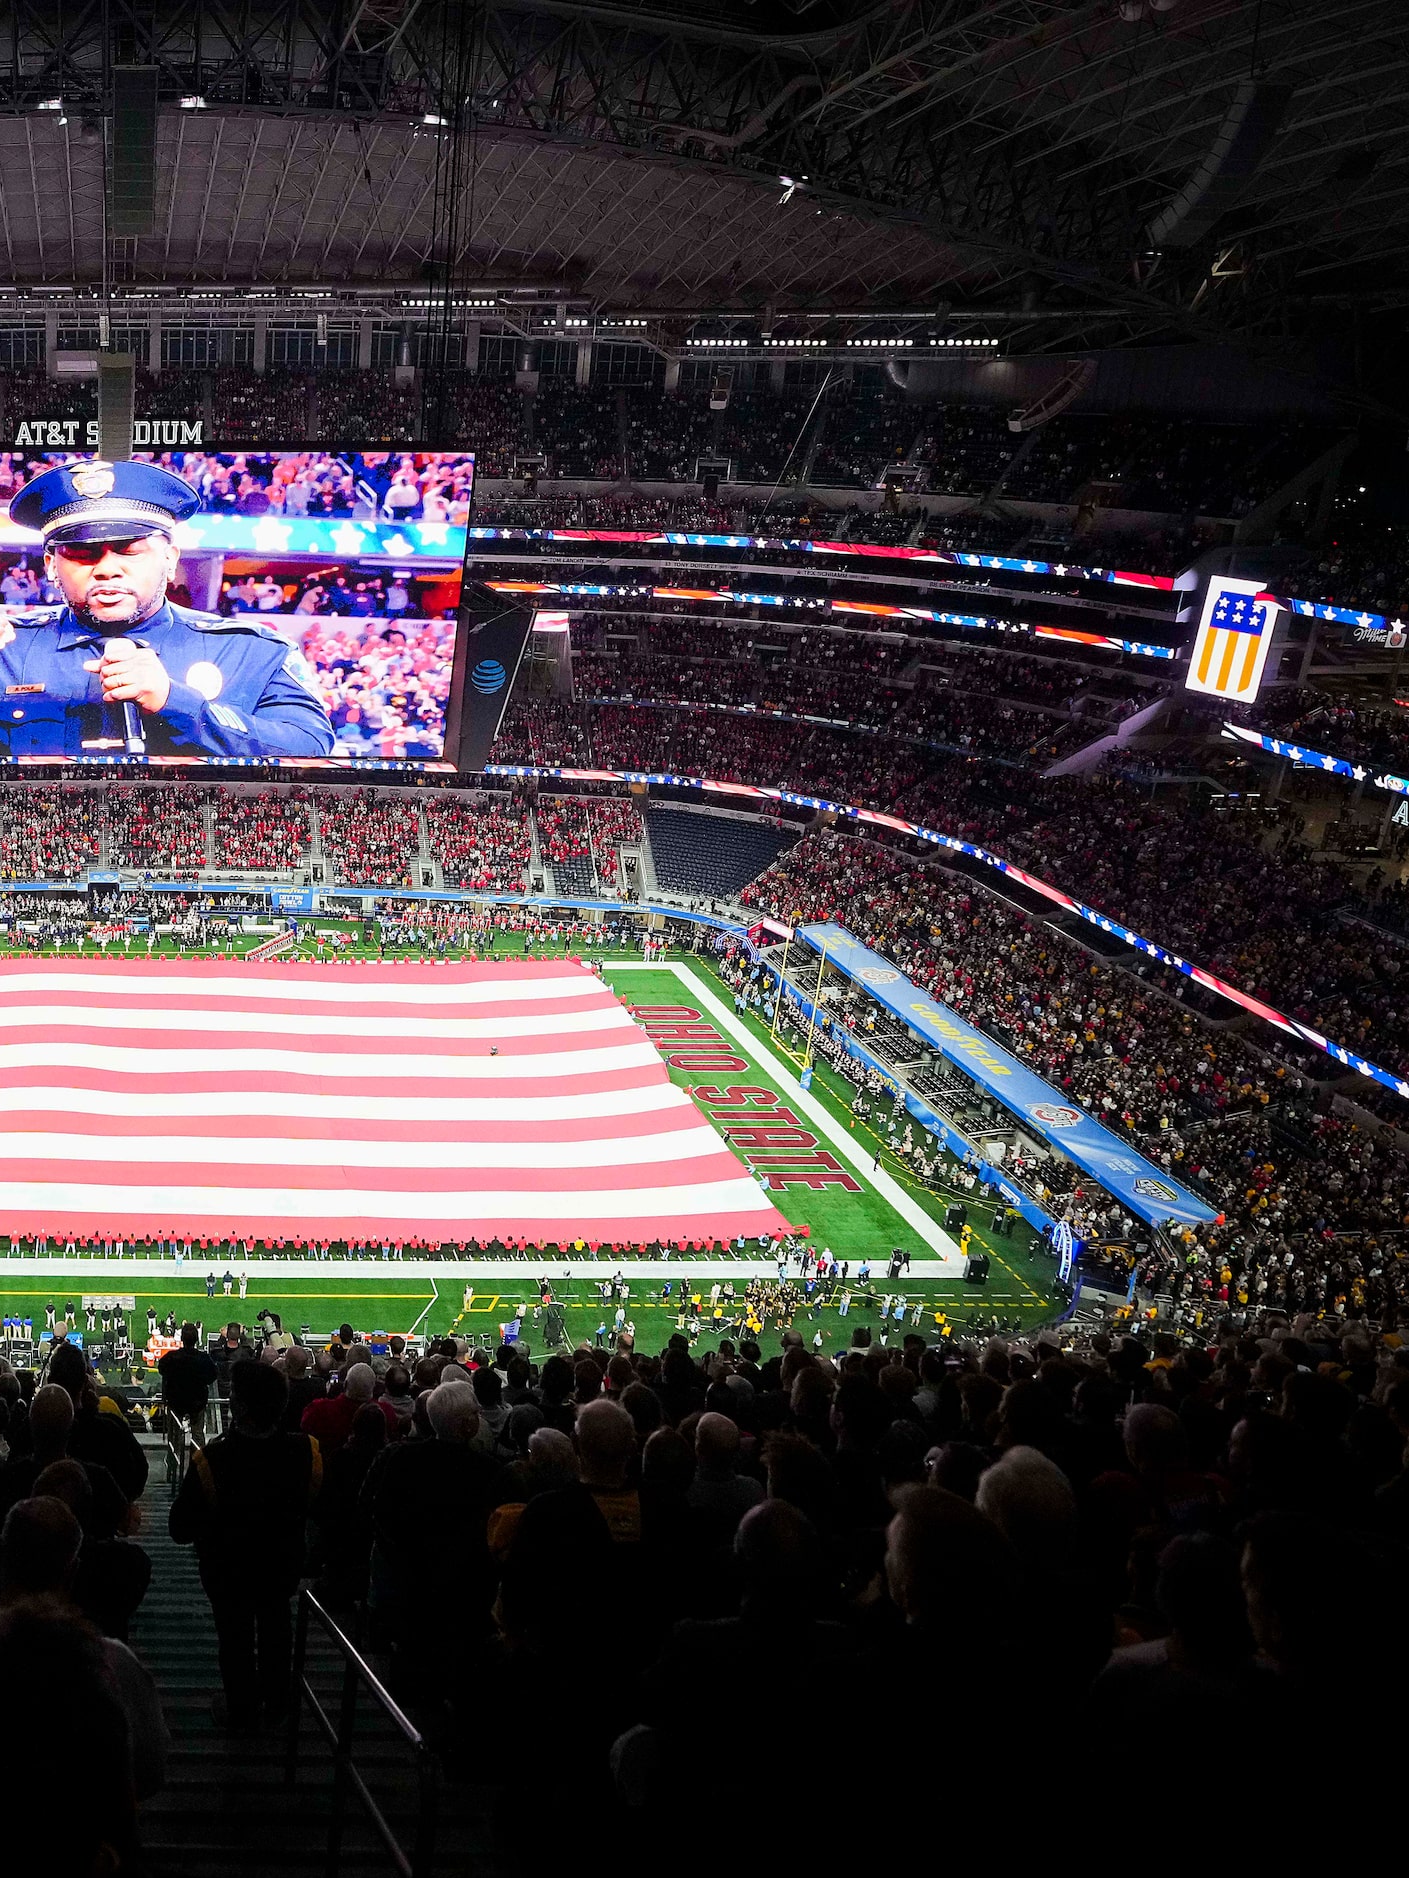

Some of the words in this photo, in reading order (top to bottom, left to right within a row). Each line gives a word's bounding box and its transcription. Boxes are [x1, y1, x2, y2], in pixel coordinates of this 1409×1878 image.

[15, 421, 80, 446] AT&T
[87, 420, 204, 446] SDIUM
[910, 1003, 1013, 1076] GOODYEAR
[633, 1005, 750, 1072] OHIO
[692, 1085, 865, 1193] STATE
